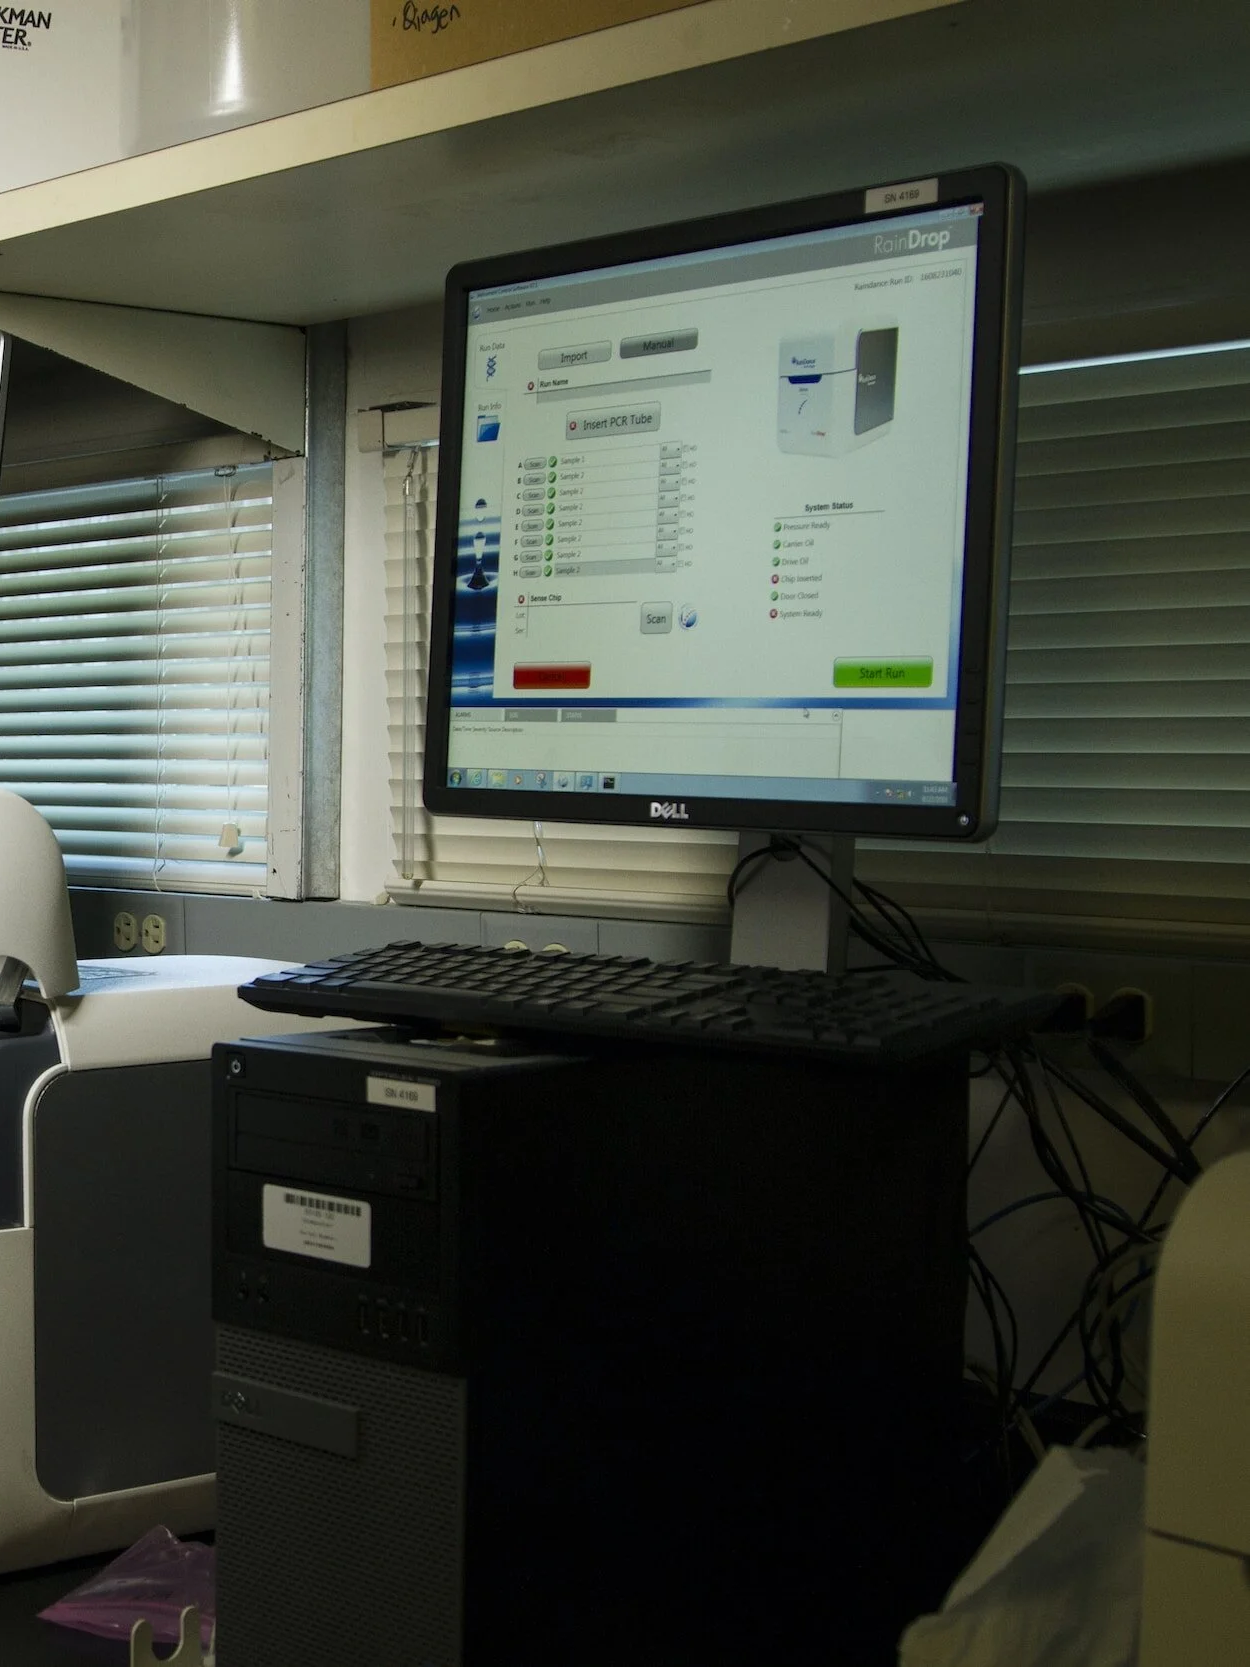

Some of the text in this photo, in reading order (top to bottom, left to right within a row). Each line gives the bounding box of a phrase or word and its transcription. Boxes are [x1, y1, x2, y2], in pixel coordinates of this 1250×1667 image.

[884, 189, 920, 204] SN 4169
[873, 229, 951, 254] RainDrop
[643, 339, 674, 351] Manual
[561, 351, 588, 364] Import
[539, 378, 569, 388] Run Name
[583, 414, 652, 430] Insert PCR Tube
[805, 501, 854, 513] System Status
[646, 614, 667, 624] Scan
[860, 667, 905, 679] Start Run
[650, 801, 689, 819] DELL
[384, 1087, 398, 1099] SN
